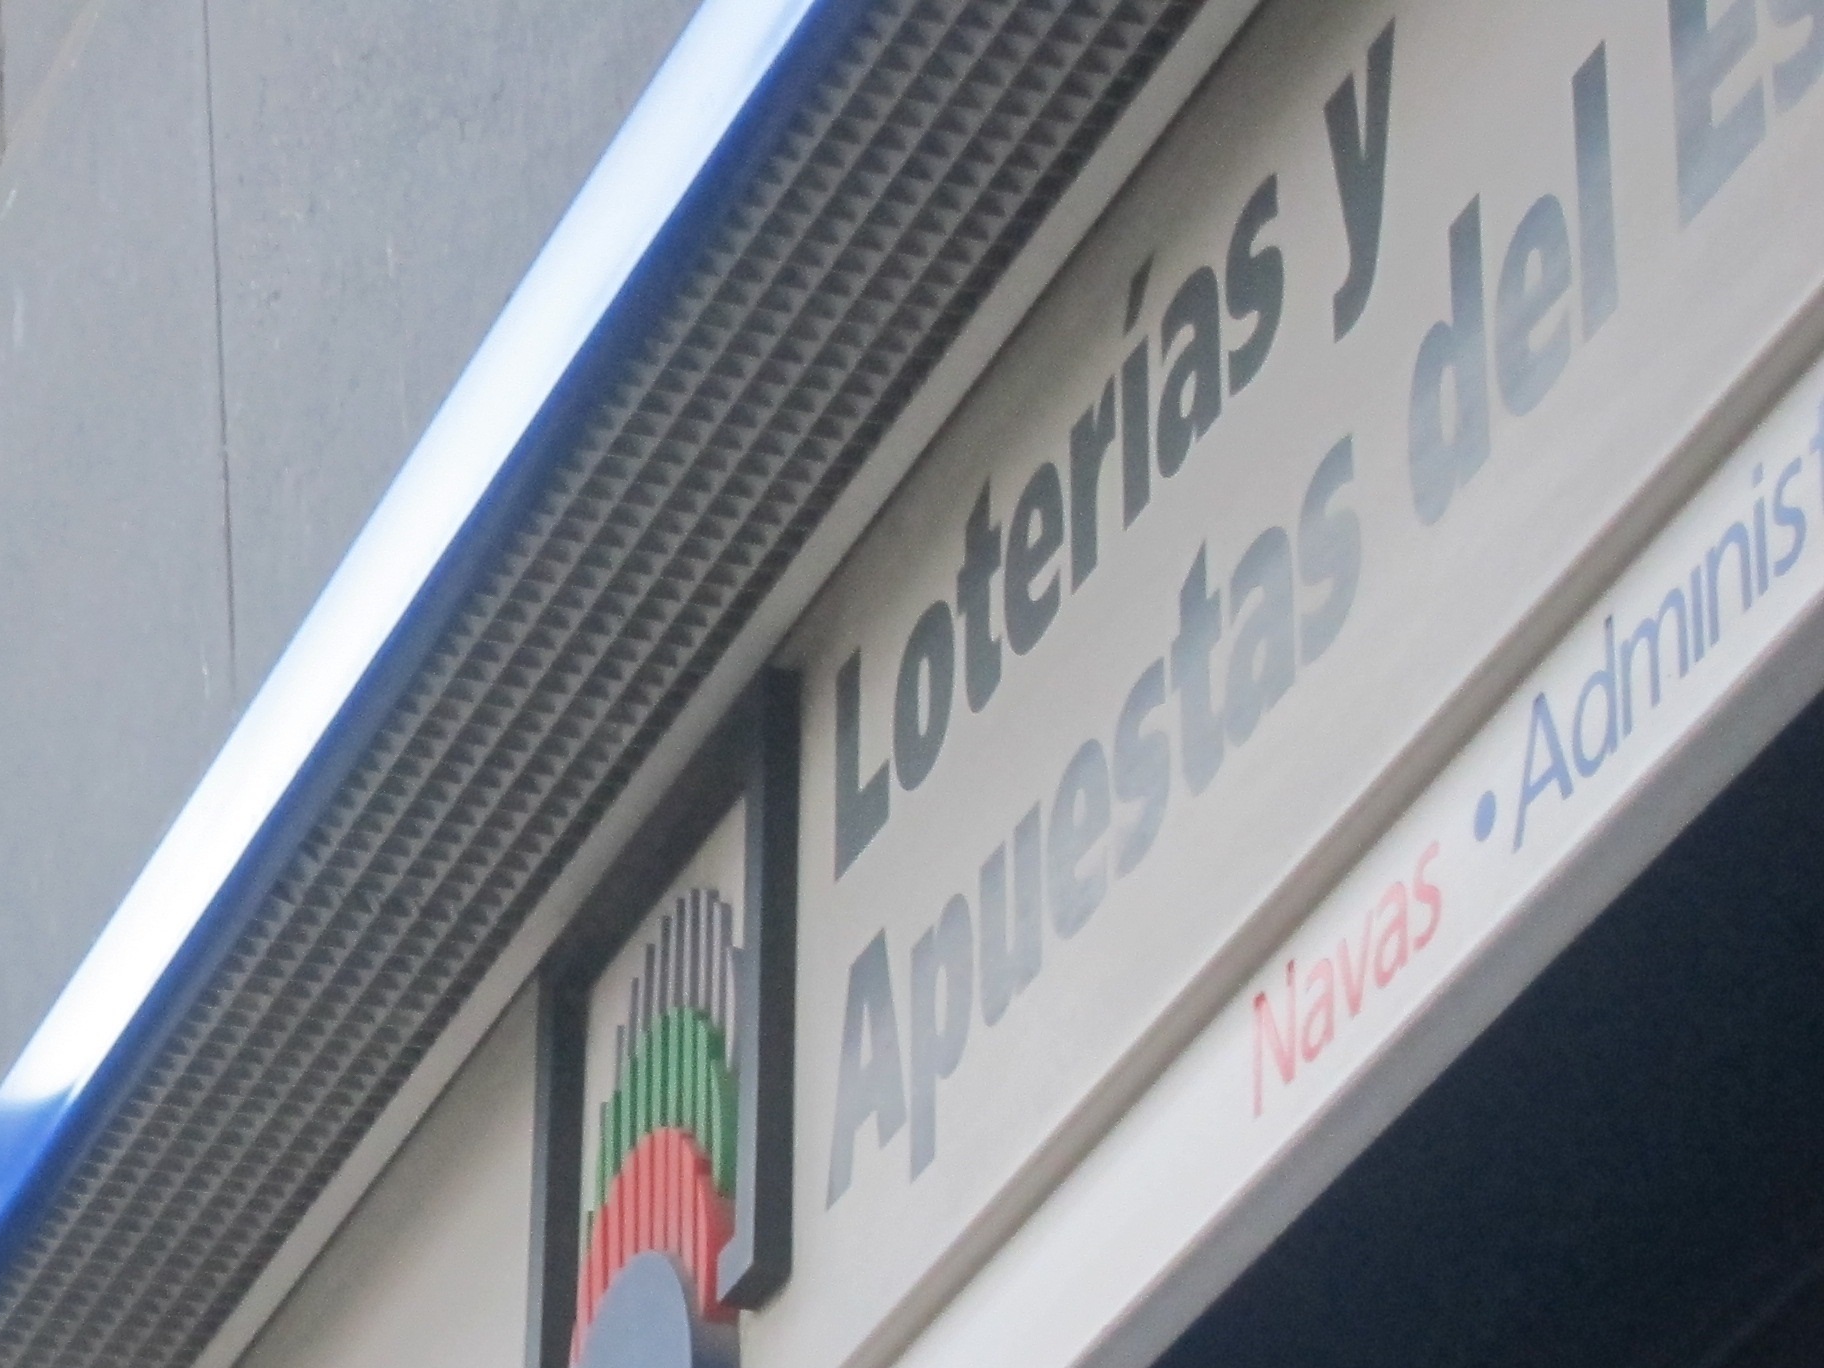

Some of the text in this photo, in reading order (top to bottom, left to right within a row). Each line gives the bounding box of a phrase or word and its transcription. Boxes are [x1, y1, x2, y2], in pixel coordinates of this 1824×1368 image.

[825, 433, 1364, 1212] Apuestas
[1408, 38, 1620, 528] del
[833, 20, 1396, 884] Loterías y
[1250, 839, 1444, 1121] Navas
